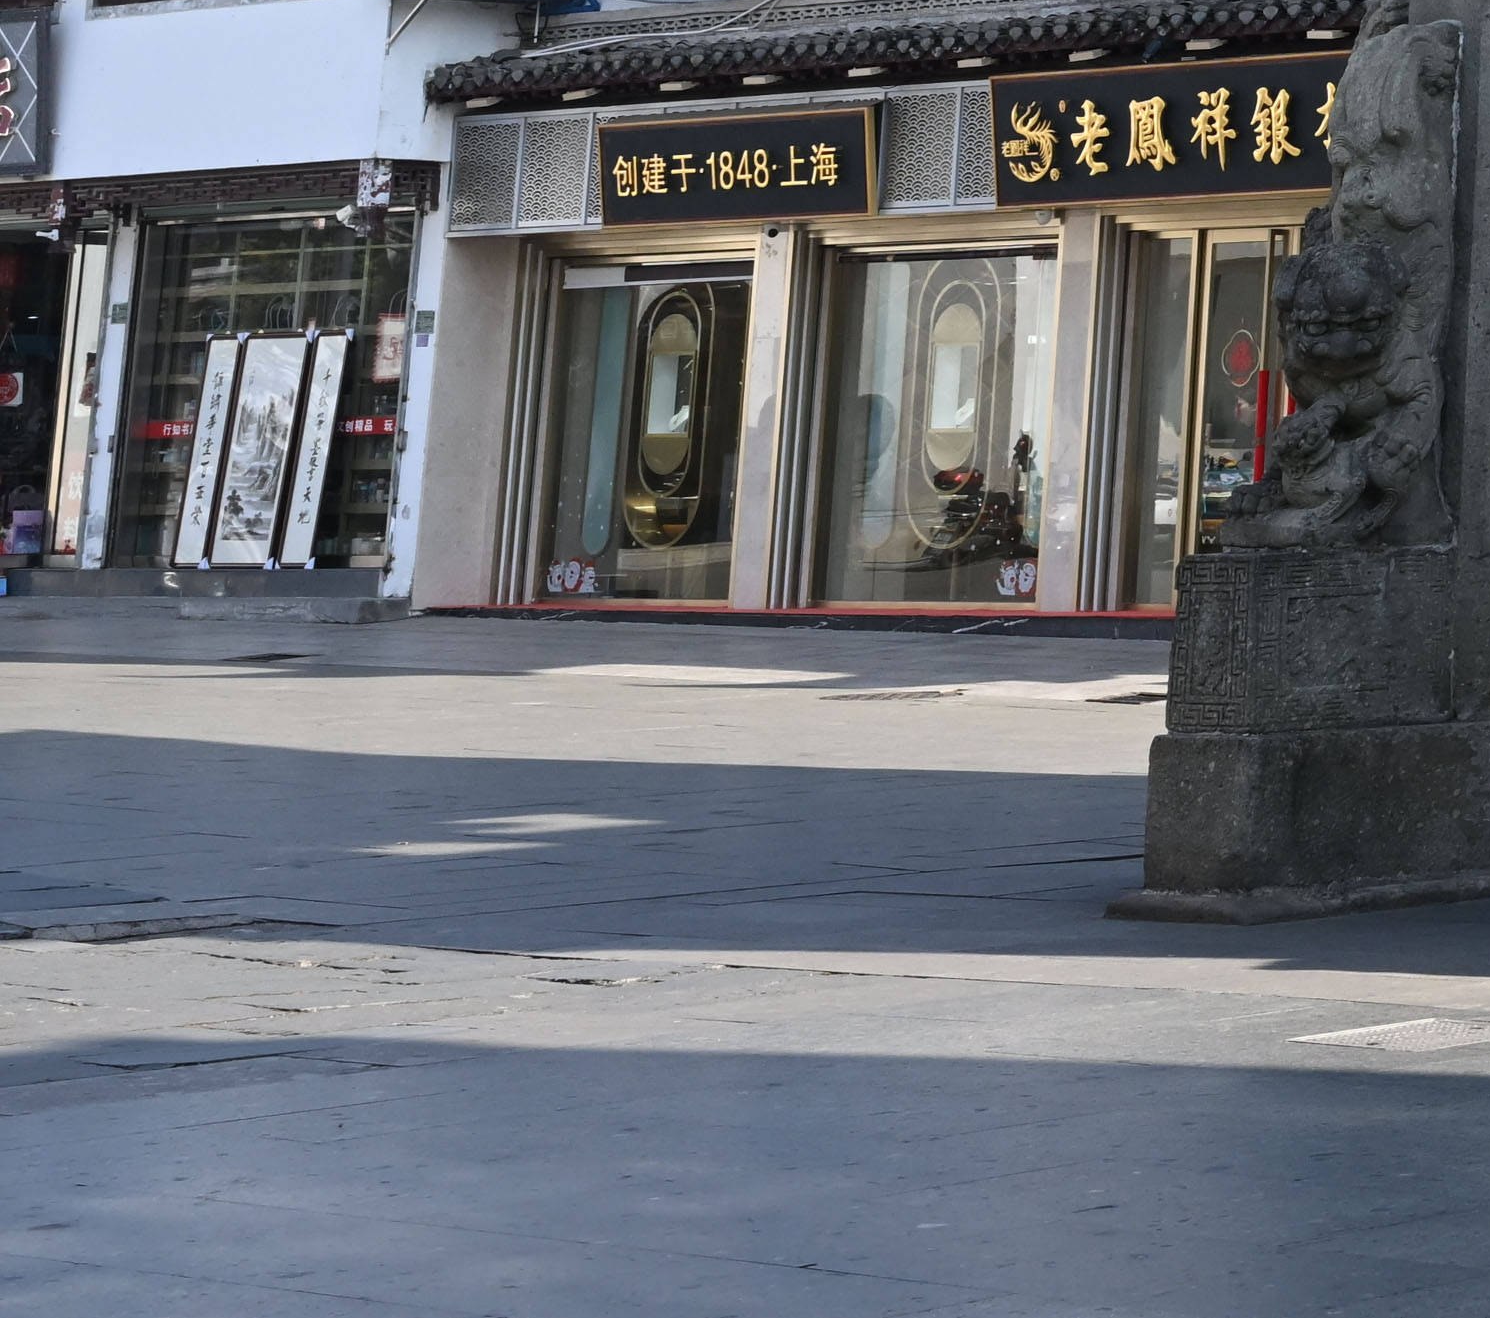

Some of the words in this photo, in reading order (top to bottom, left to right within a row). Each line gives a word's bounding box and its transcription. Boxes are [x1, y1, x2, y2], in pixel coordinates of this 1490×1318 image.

[612, 142, 840, 198] 创建于·1848·上海
[162, 423, 194, 437] 行知书
